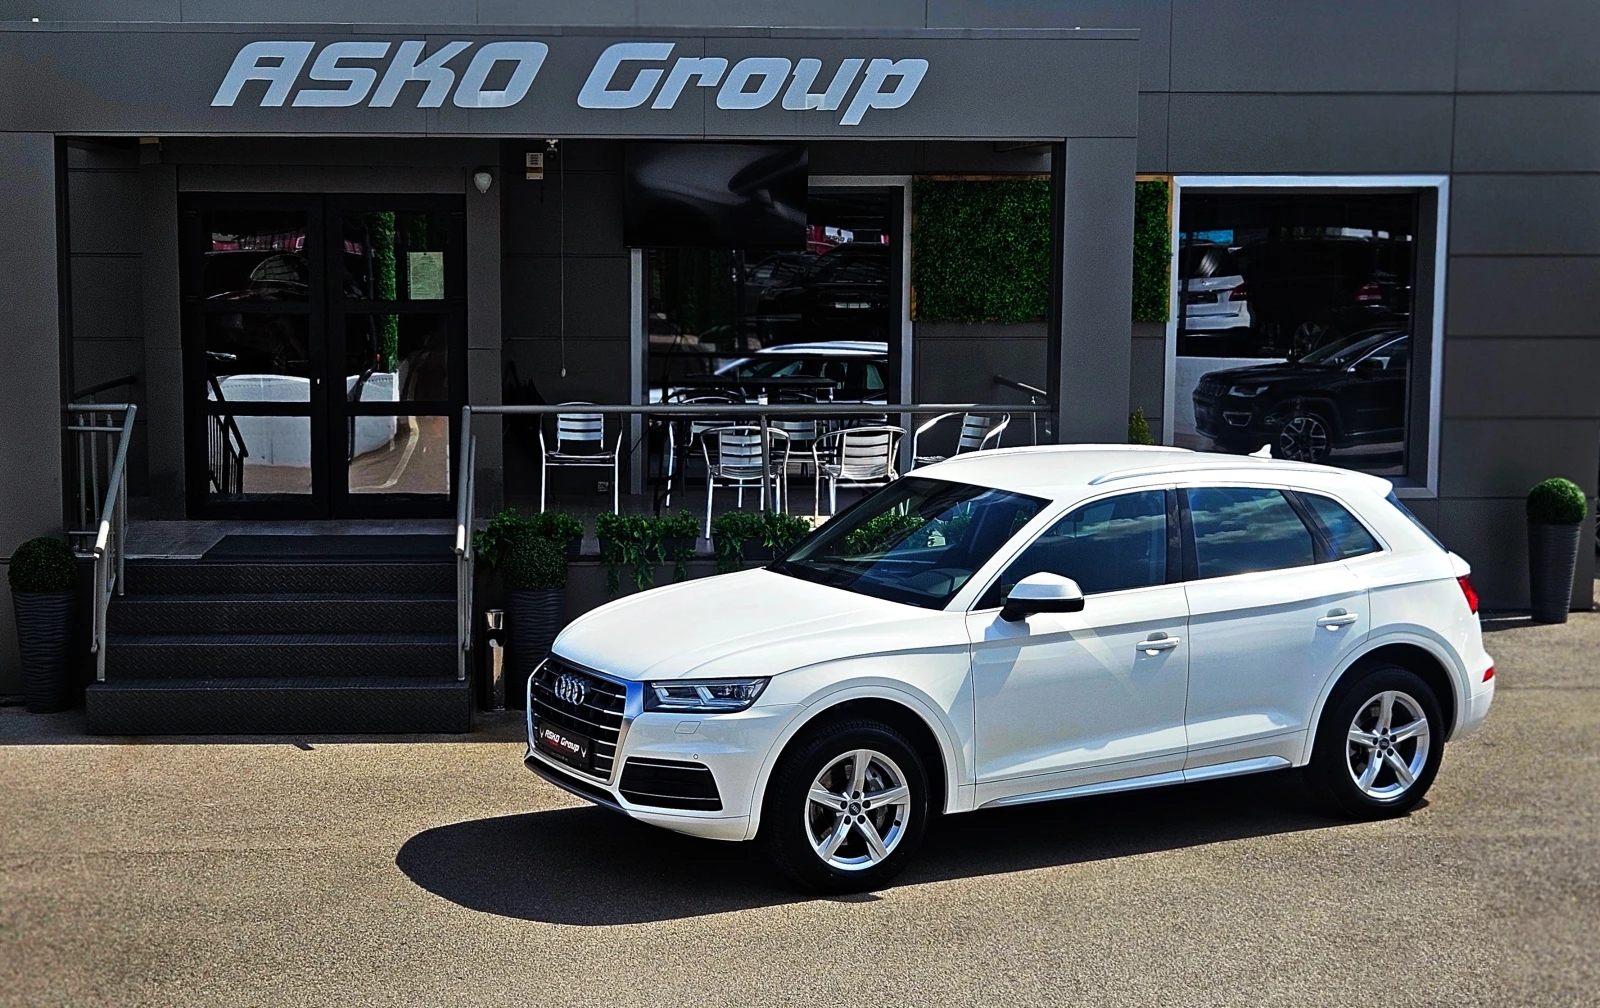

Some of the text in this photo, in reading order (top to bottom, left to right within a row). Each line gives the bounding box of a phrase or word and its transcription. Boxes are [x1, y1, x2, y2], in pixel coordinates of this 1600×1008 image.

[210, 41, 929, 125] ASKO Group
[544, 729, 580, 753] ASKO Group
